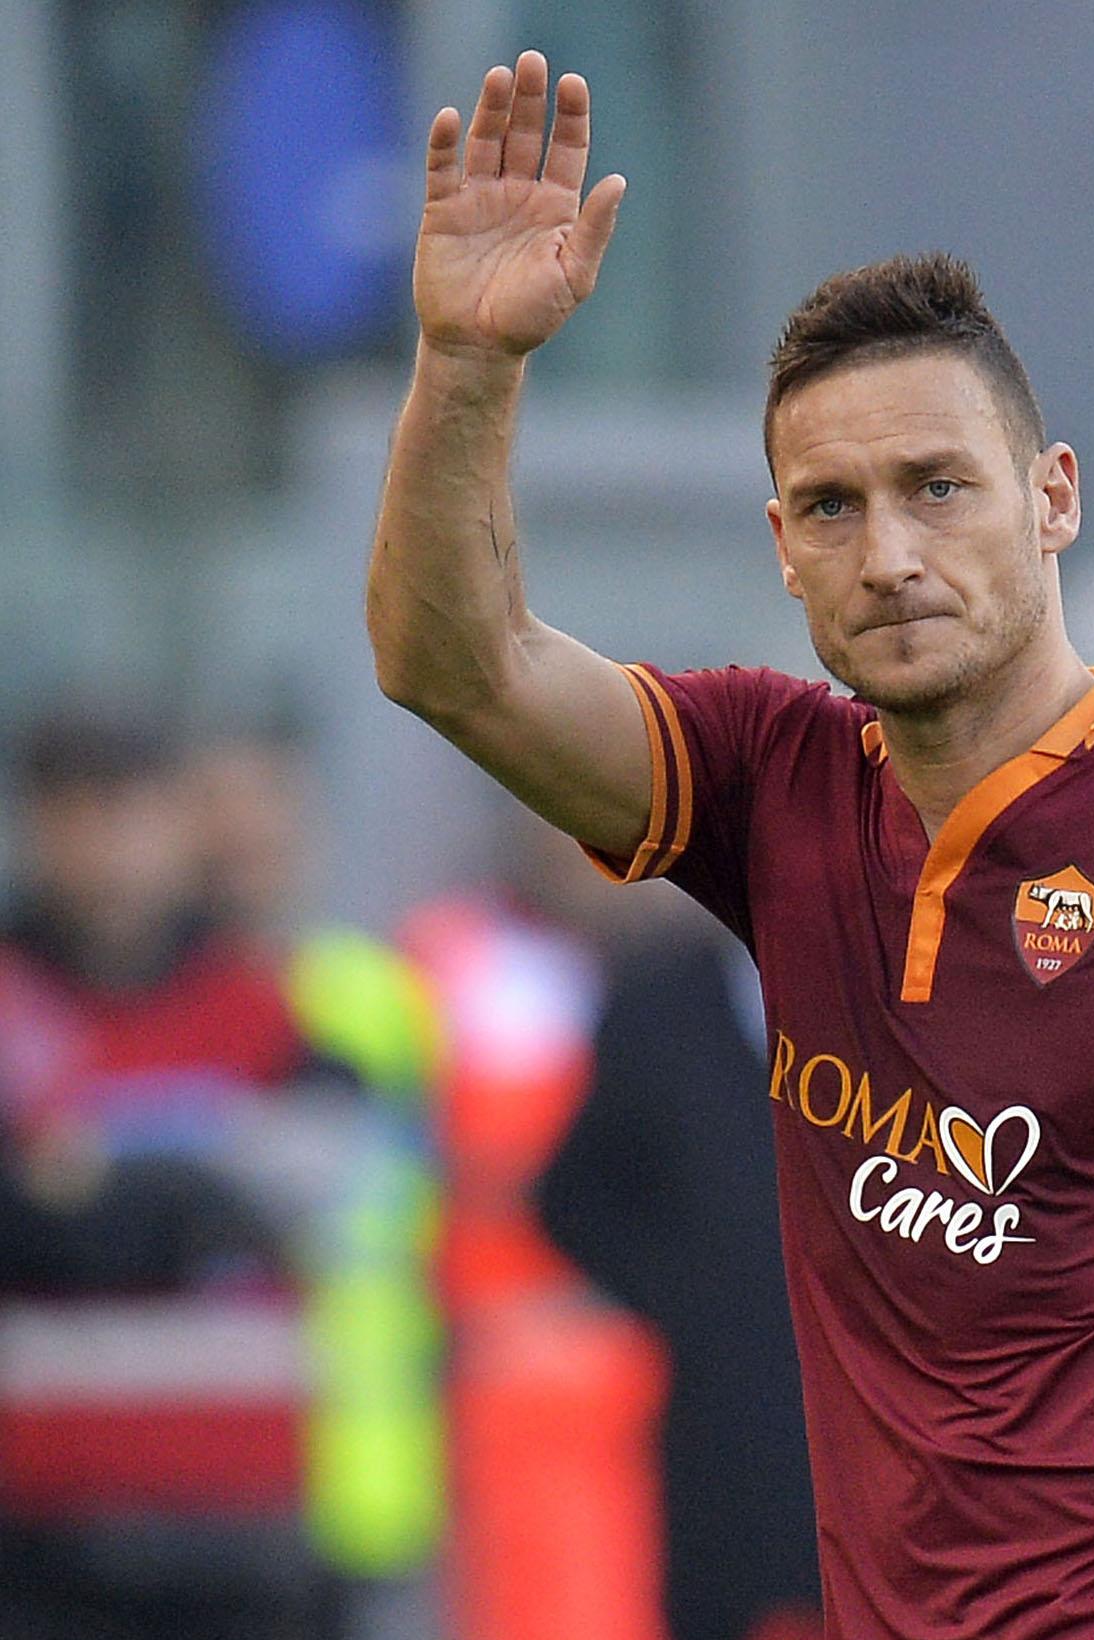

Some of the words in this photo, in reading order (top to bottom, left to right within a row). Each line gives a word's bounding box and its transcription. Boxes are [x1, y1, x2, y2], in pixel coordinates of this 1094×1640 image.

[1024, 932, 1082, 953] ROMA
[1036, 958, 1062, 971] 1927
[769, 1029, 949, 1175] ROMA
[850, 1156, 1036, 1265] Cares
